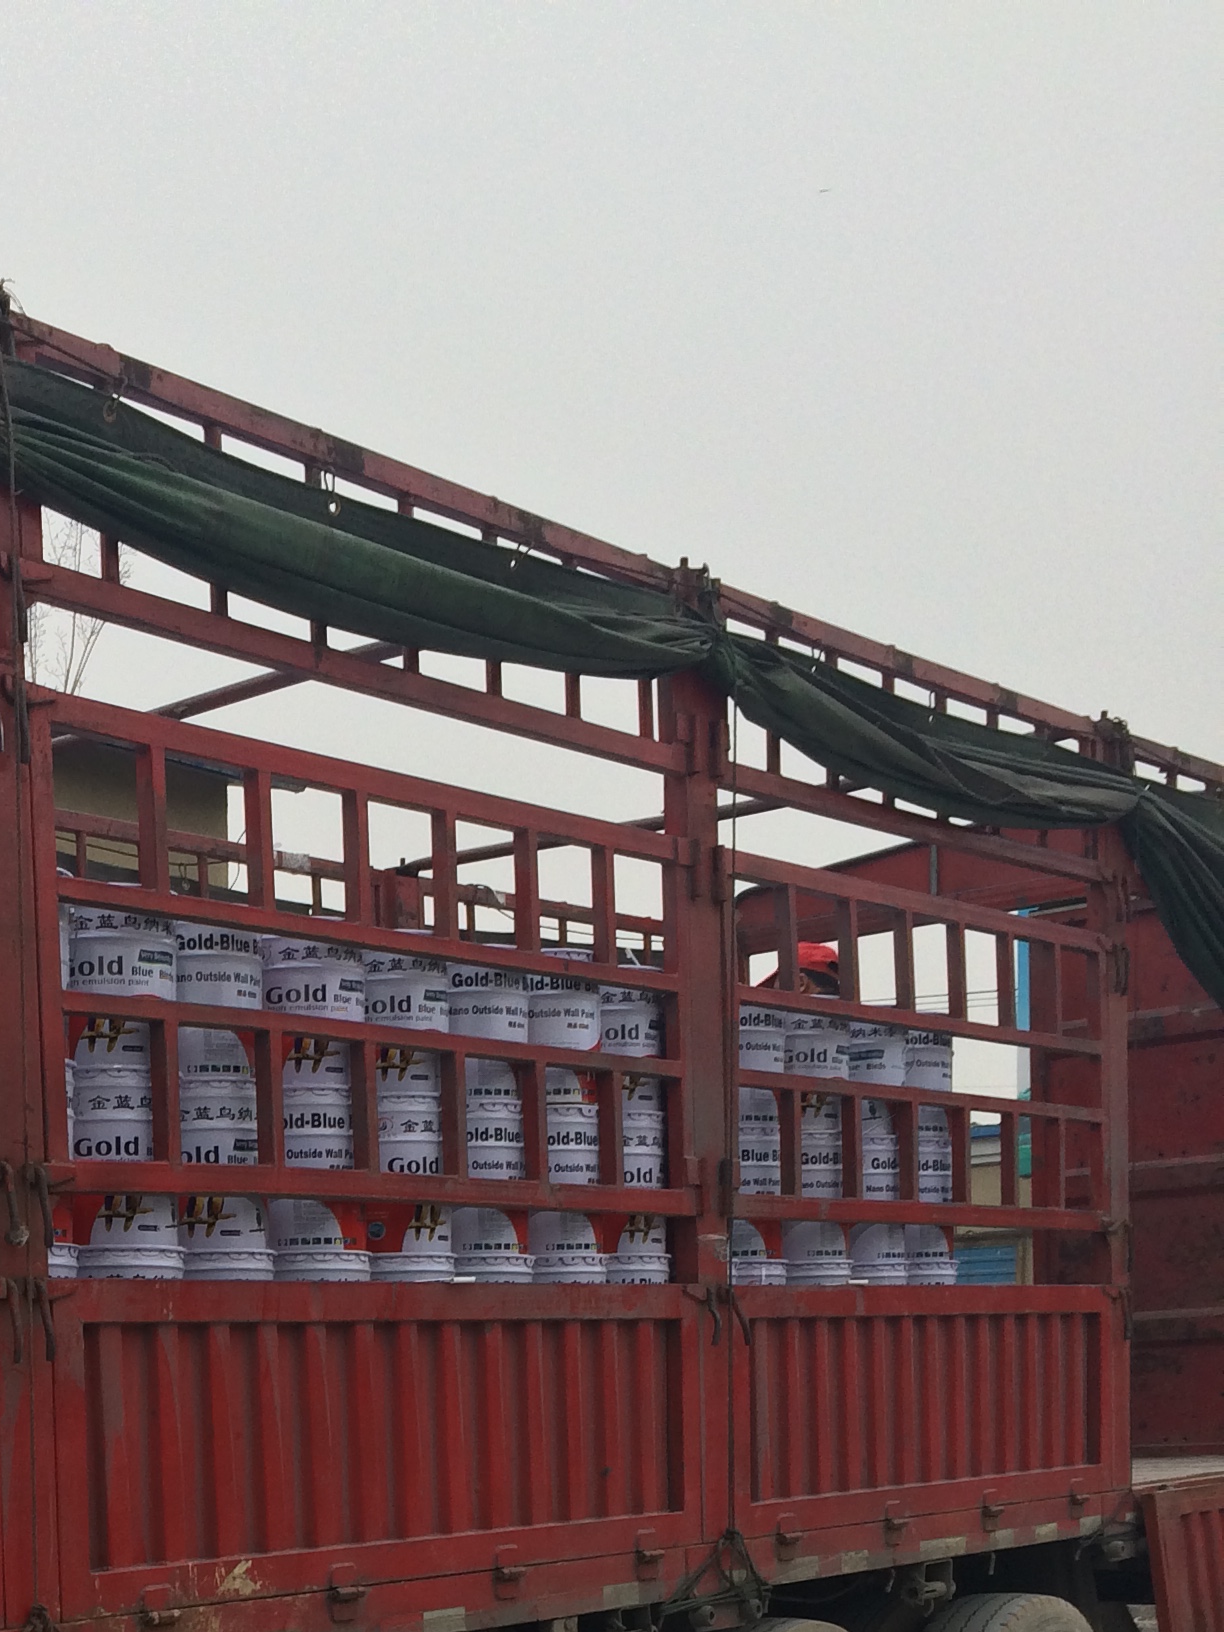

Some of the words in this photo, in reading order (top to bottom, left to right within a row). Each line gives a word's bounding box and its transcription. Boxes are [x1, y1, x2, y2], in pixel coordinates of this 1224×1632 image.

[176, 932, 250, 953] Gold-Blue
[131, 965, 154, 978] Blue
[195, 970, 232, 983] Outside
[451, 971, 520, 990] Gold-Blue
[265, 983, 327, 1005] Gold
[739, 1013, 783, 1028] old-Blue
[604, 1023, 640, 1041] old
[784, 1048, 828, 1064] Gold
[466, 1126, 520, 1143] old-Blue
[547, 1130, 598, 1147] old-Blue
[73, 1135, 139, 1157] Gold
[286, 1148, 323, 1160] Outside
[181, 1145, 219, 1164] old
[227, 1154, 249, 1165] Blue
[801, 1151, 839, 1165] Gold-B
[387, 1156, 439, 1174] Gold
[623, 1166, 653, 1184] old
